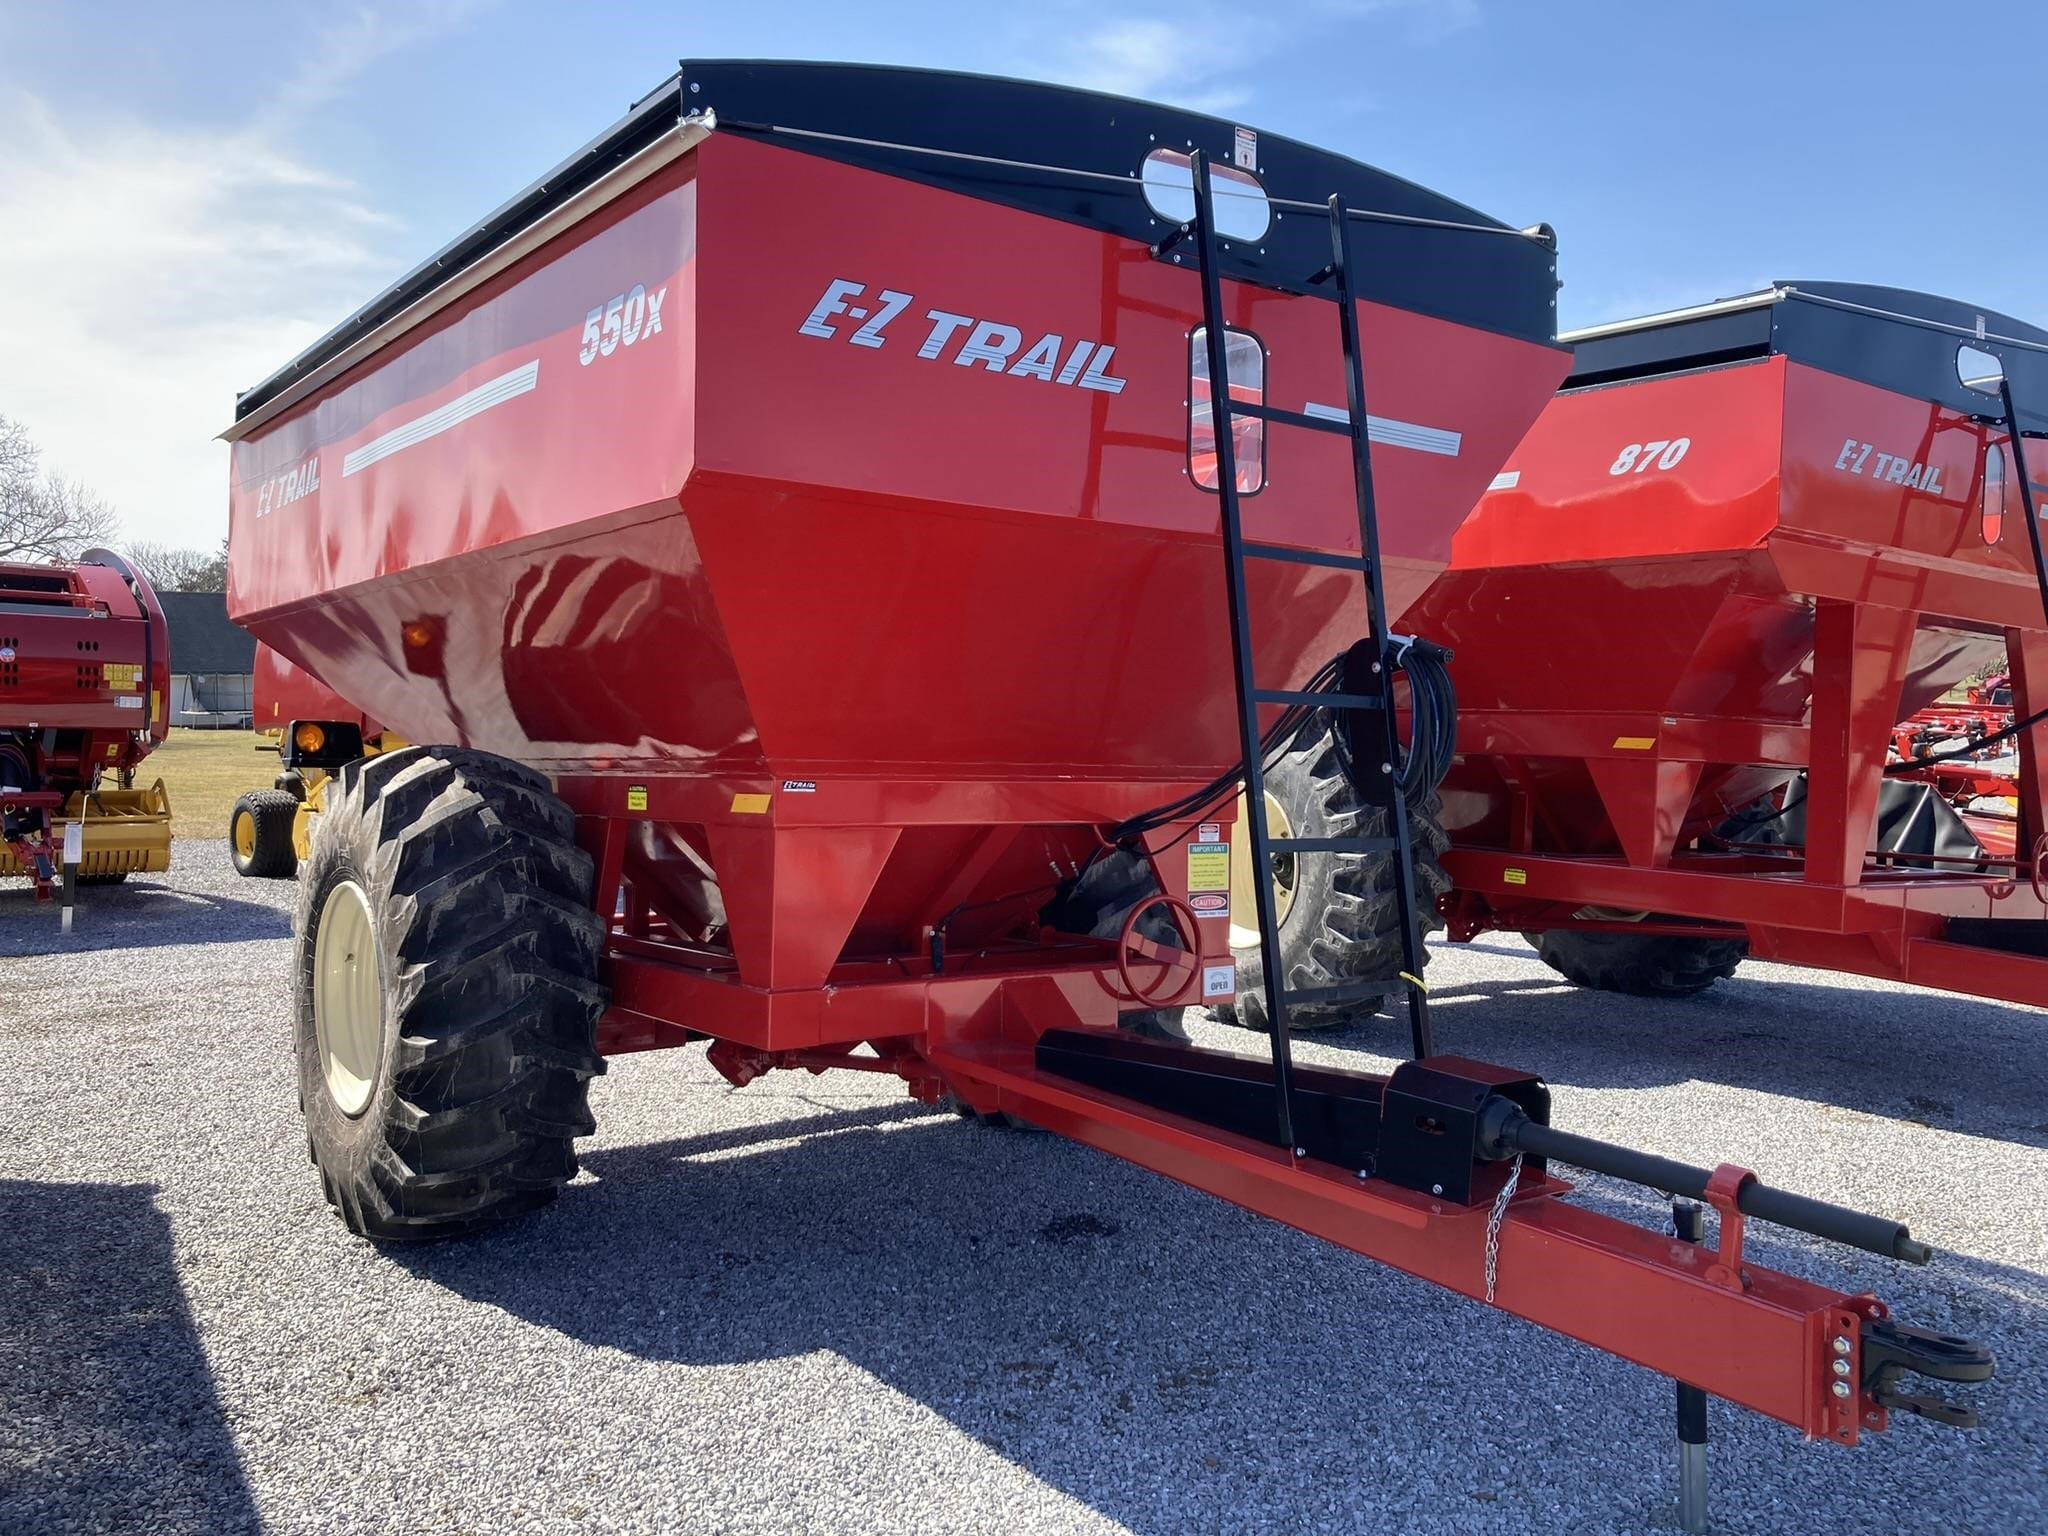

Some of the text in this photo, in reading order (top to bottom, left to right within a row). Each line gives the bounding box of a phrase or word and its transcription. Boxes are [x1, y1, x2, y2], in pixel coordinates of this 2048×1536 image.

[798, 278, 1128, 394] E-Z TRAIL
[1608, 437, 1691, 476] 870
[1834, 438, 1944, 495] E-Z TRAIL
[276, 456, 320, 509] TRAIL
[1191, 845, 1226, 853] IMPORTANT
[1194, 898, 1223, 907] CAUTION
[1210, 981, 1229, 991] OPEN
